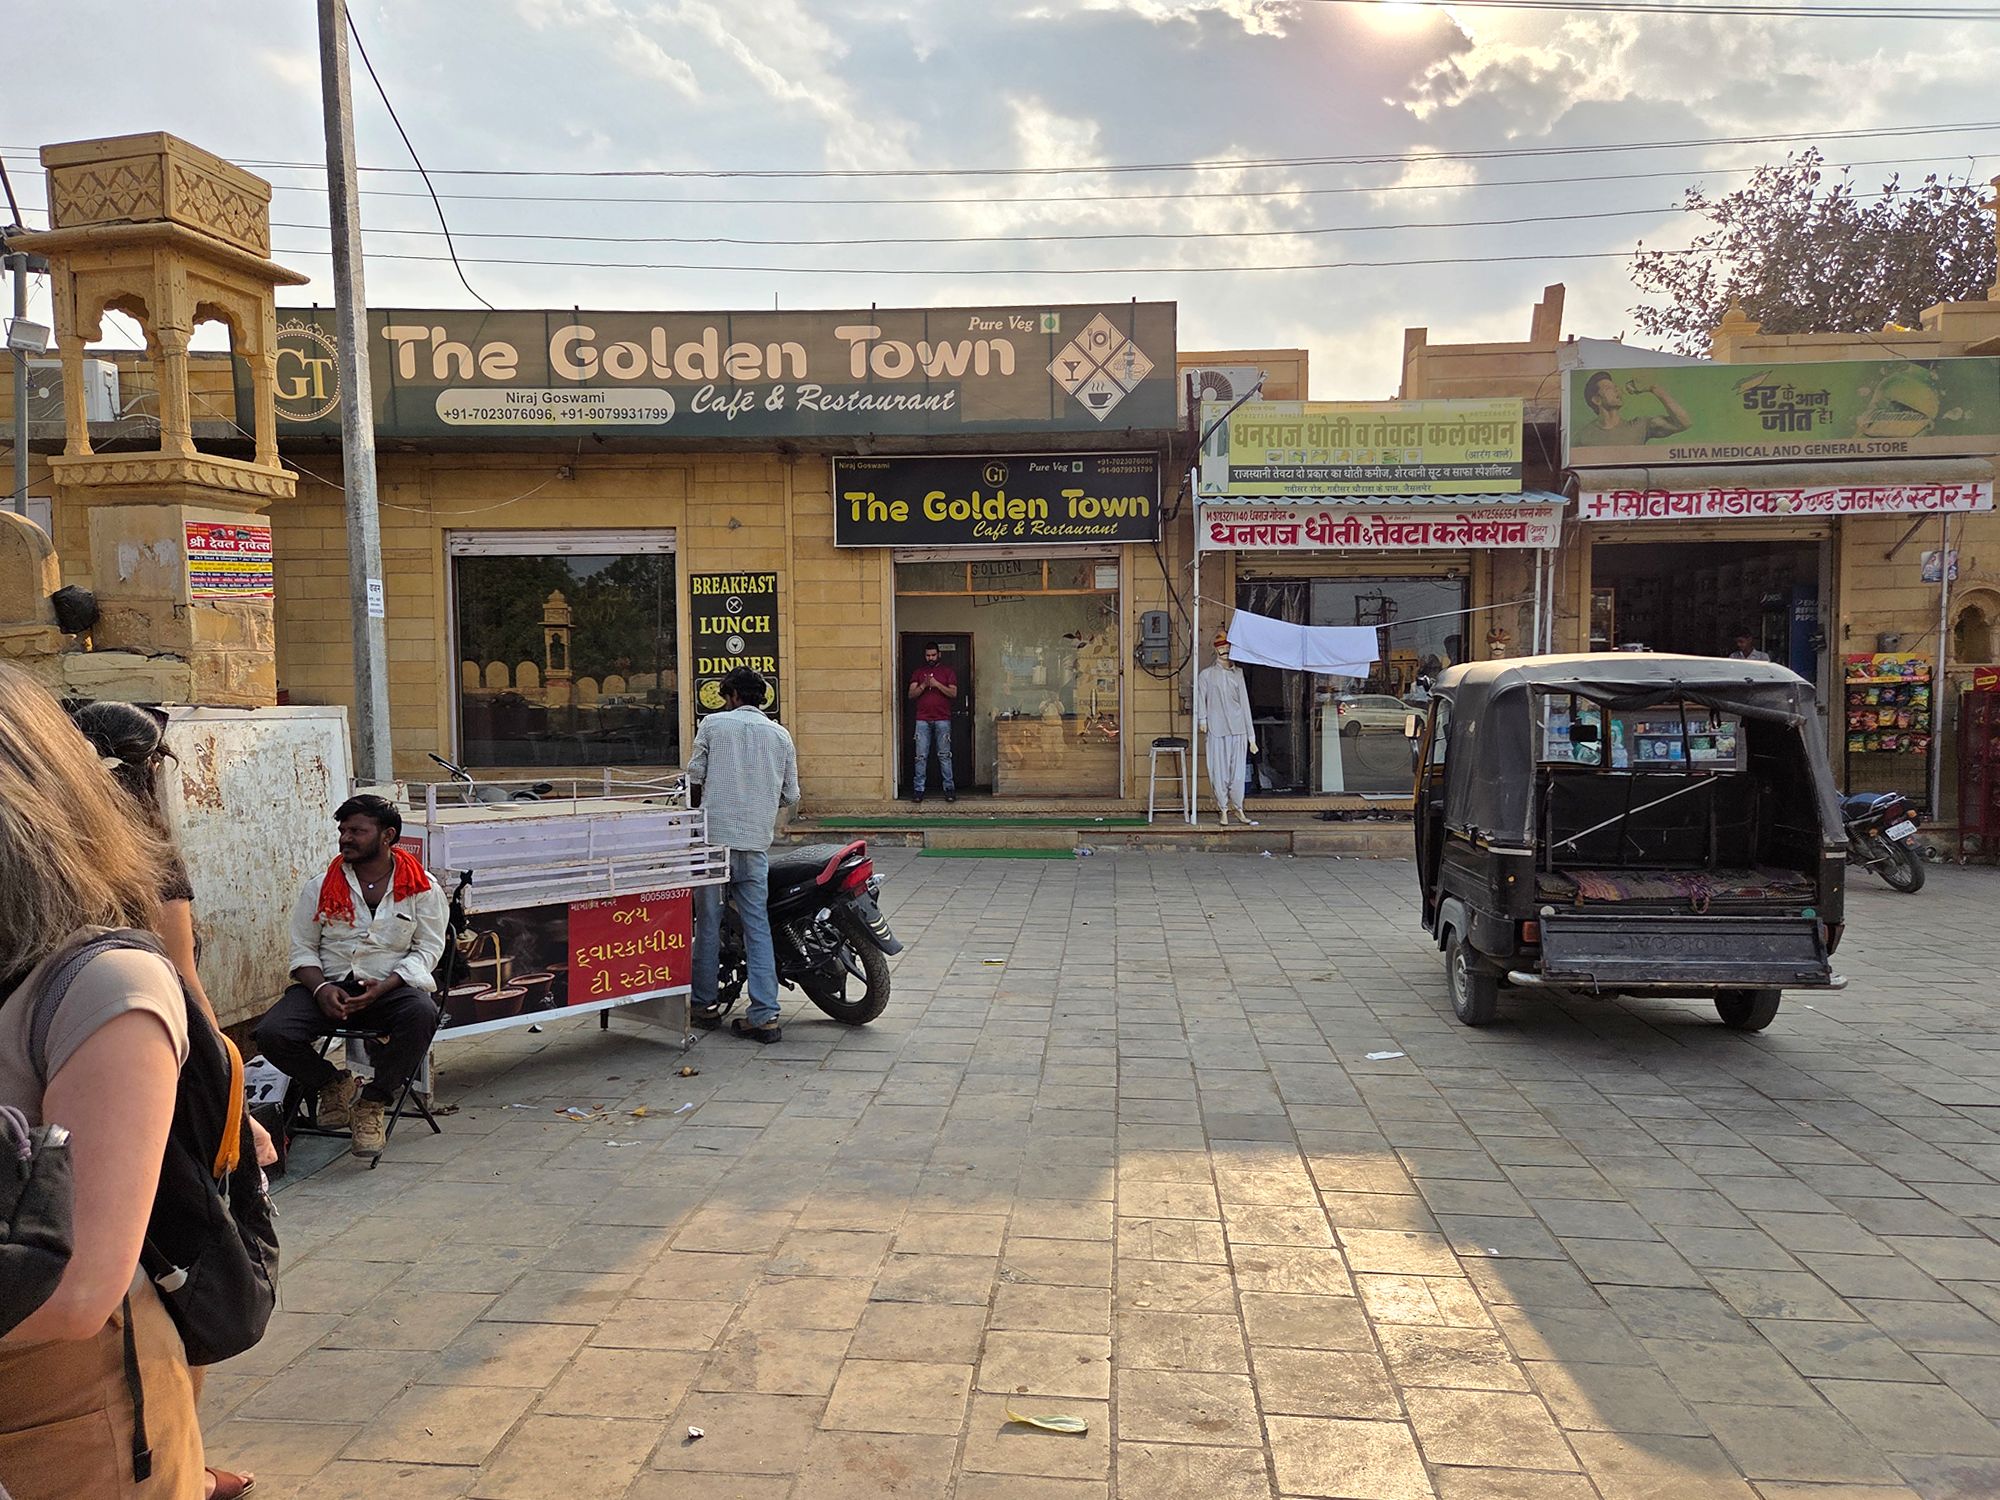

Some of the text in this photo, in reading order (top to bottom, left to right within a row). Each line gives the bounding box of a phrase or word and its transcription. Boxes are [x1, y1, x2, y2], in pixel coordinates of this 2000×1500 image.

[968, 316, 1034, 332] Pure Veg
[381, 324, 1016, 380] The Golden Town
[272, 348, 333, 399] GT
[506, 392, 605, 405] Niraj Goswami
[691, 384, 956, 420] Café & Restaurant
[1743, 384, 1831, 409] डर के आगे
[443, 407, 668, 421] +91-7023076096, +91-9079931799
[1758, 402, 1816, 432] जीत
[1234, 414, 1517, 448] धनराज धोती व तेवटा कलेक्शन
[1669, 442, 1908, 459] SILIYA MEDICAL AND GENERAL STORE
[839, 461, 890, 470] Niraj Goswami
[1029, 462, 1068, 472] Pure Veg
[1428, 466, 1441, 480] सूट
[1443, 467, 1450, 477] व
[1452, 466, 1472, 477] साफा
[843, 489, 1150, 522] The Golden Town
[1610, 488, 1704, 517] सिलिया
[1907, 482, 1963, 509] स्टोर
[973, 520, 1118, 541] Café & Restaurant
[1210, 512, 1528, 545] धनराज धोती & तेवटा कलेक्शन
[189, 535, 205, 548] श्री
[971, 560, 1022, 575] GOLDEN
[693, 575, 775, 594] BREAKFAST
[700, 616, 770, 634] LUNCH
[613, 907, 650, 925] જય
[590, 963, 672, 994] ટી સ્ટોલ
